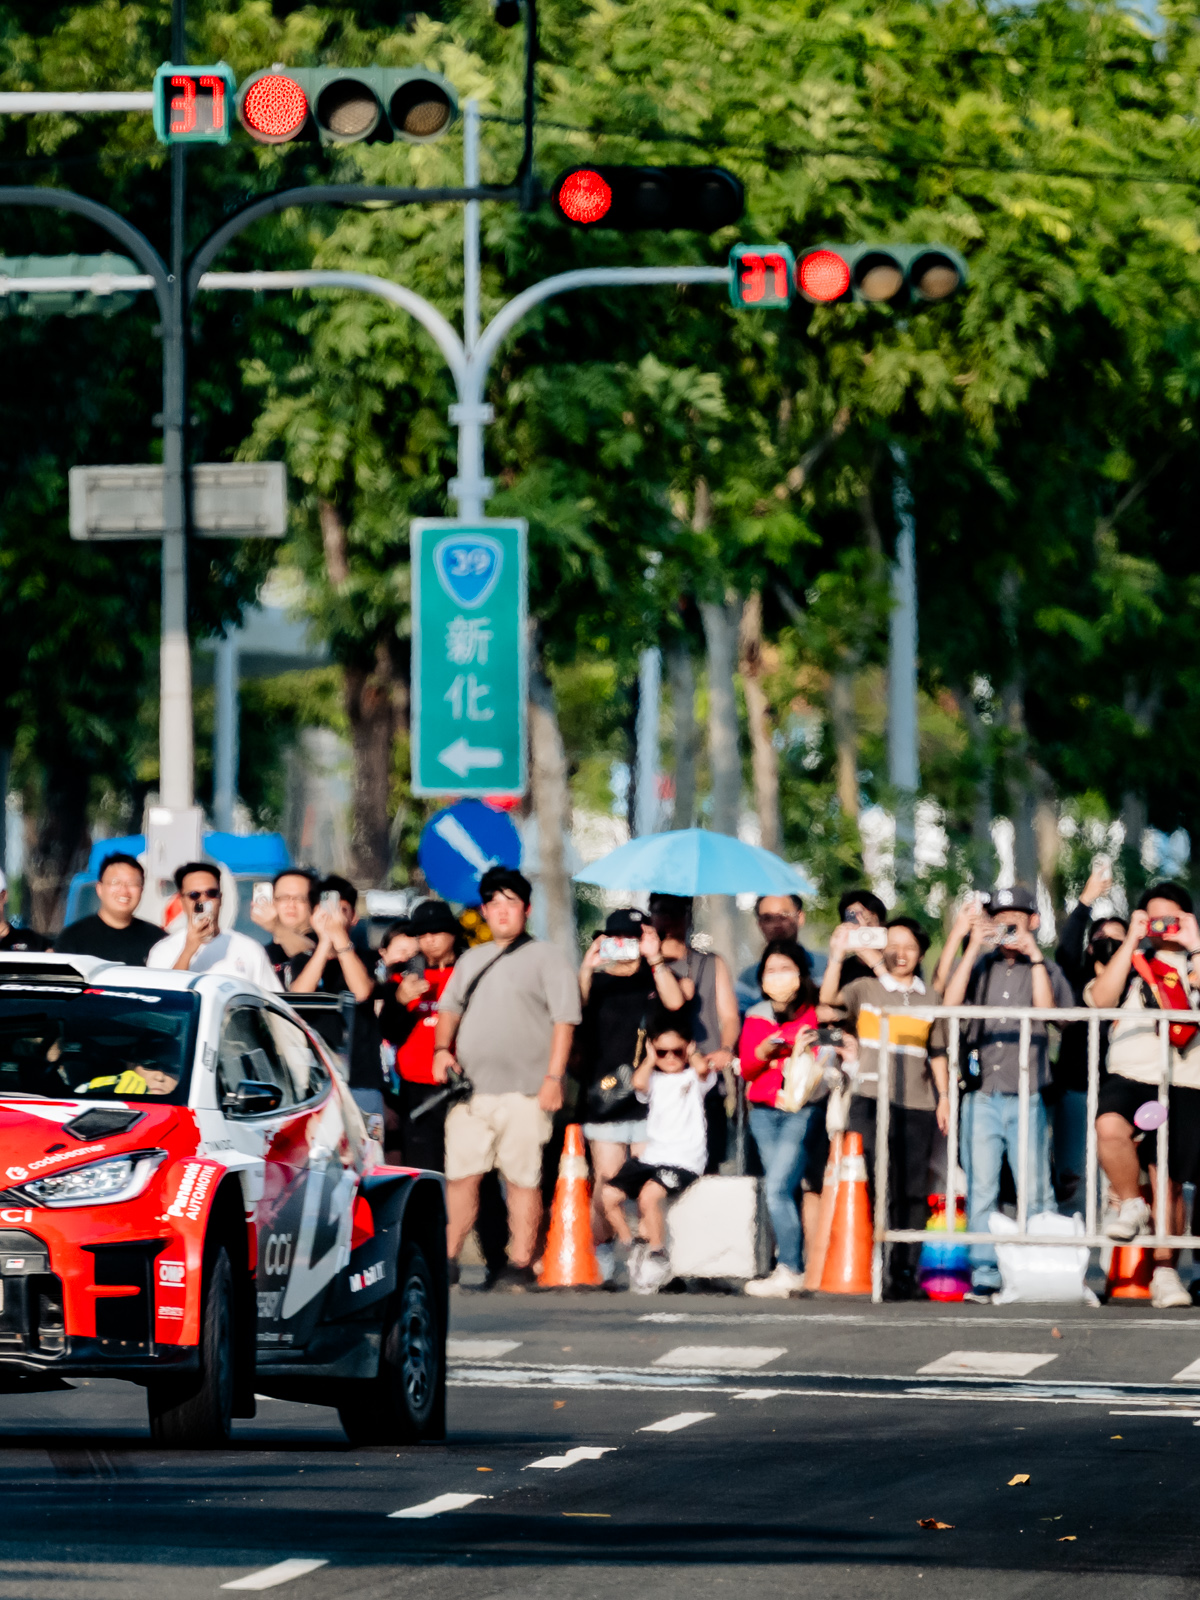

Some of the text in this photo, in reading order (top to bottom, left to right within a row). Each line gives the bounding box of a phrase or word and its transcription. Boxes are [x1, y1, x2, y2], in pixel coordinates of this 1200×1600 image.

[171, 75, 225, 133] 37
[741, 252, 788, 303] 37
[449, 547, 492, 577] 39
[443, 614, 495, 722] 新化
[83, 988, 161, 1003] Racing
[27, 1144, 107, 1170] codebeamer
[167, 1162, 202, 1217] Panasonic
[159, 1264, 186, 1283] OMP
